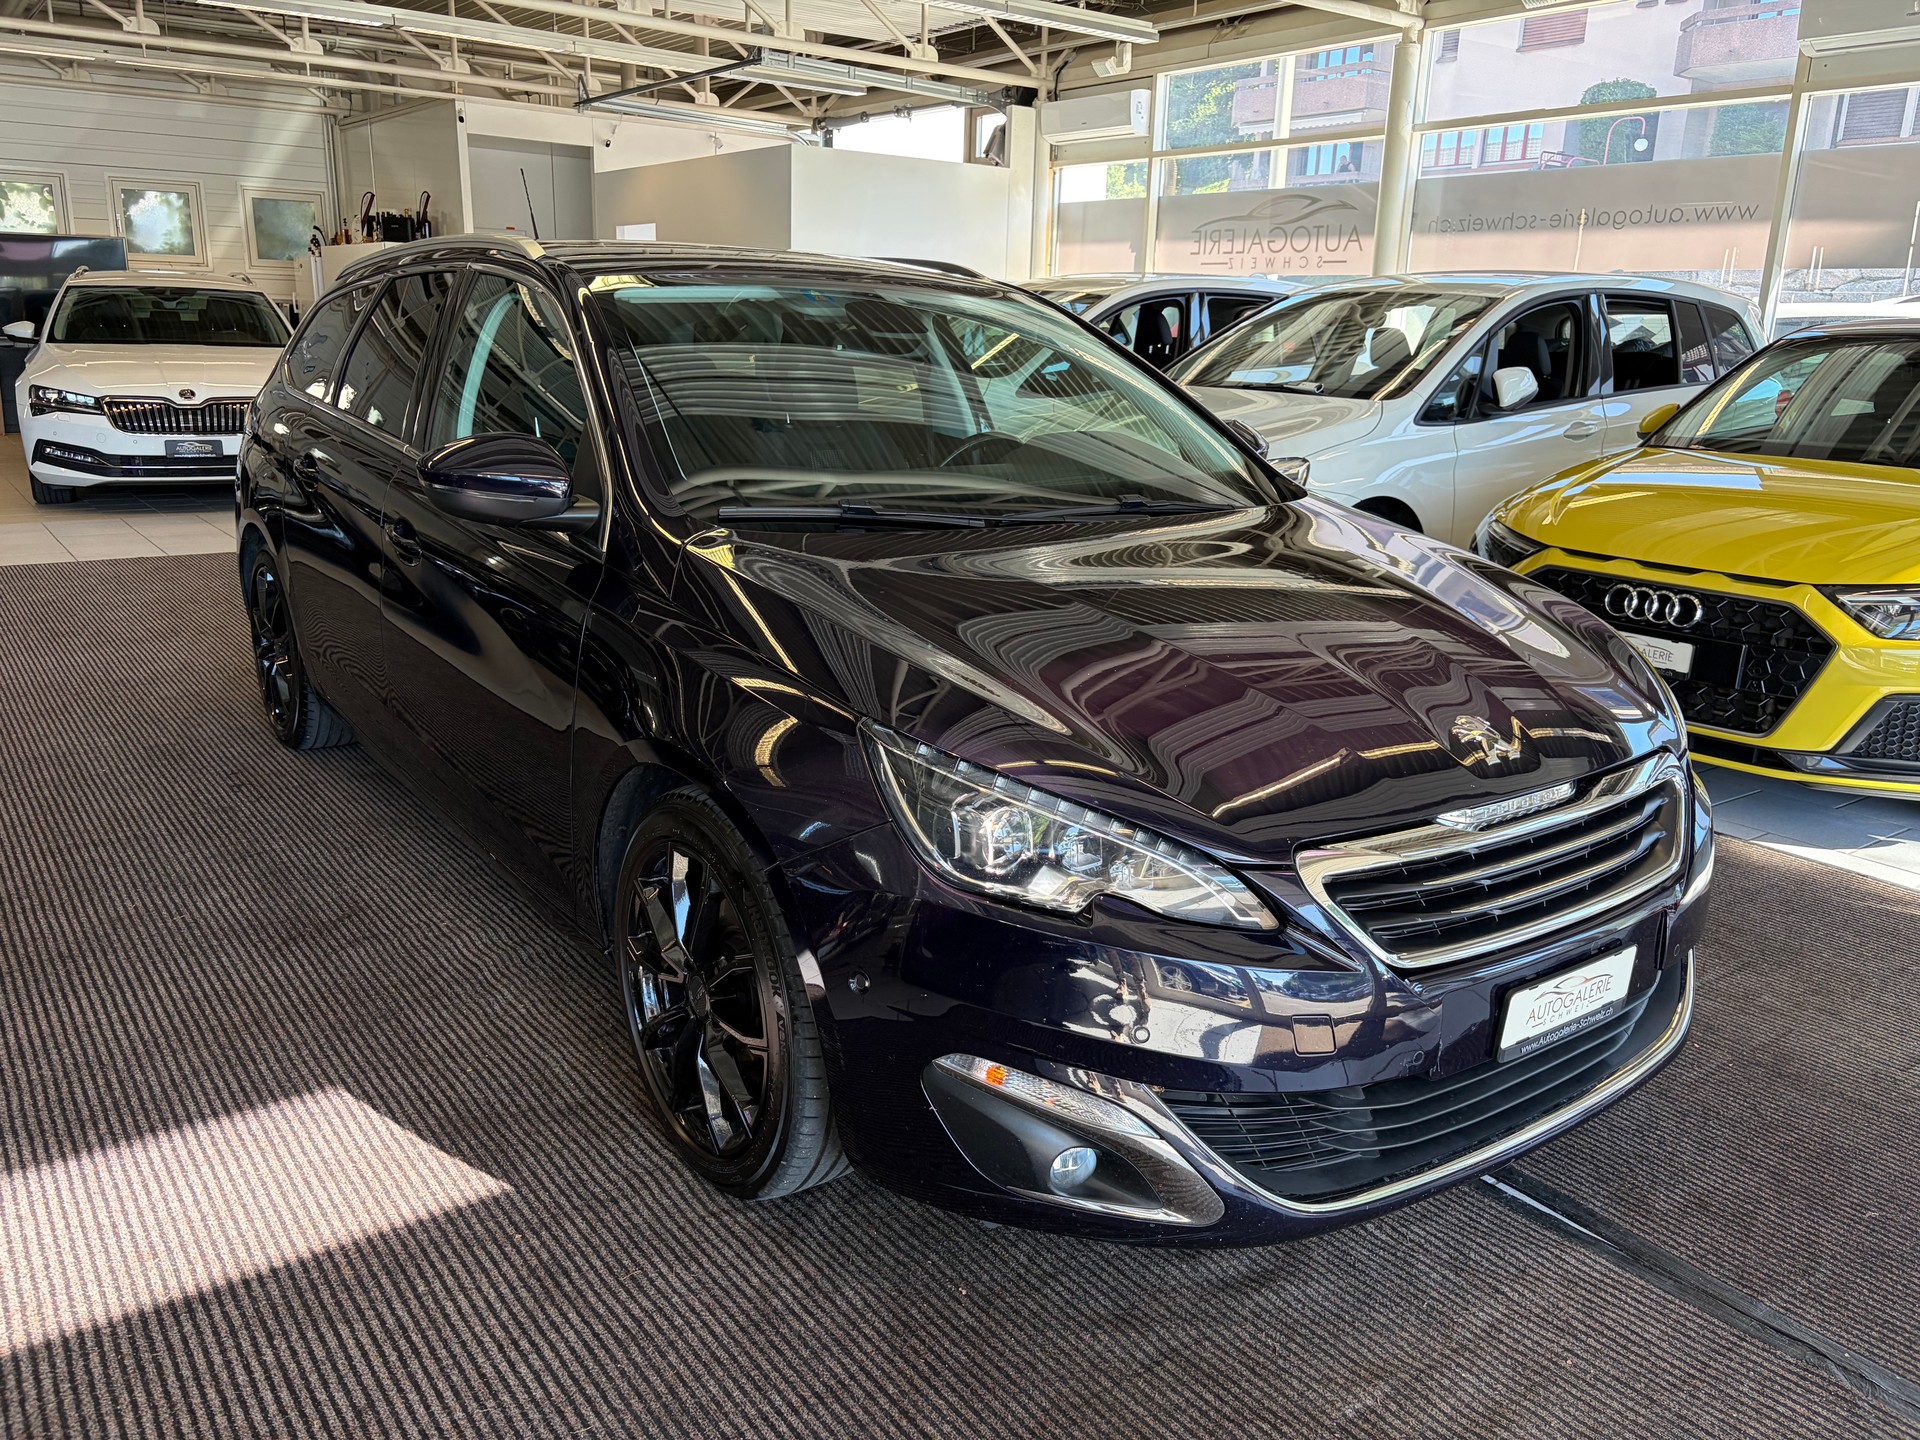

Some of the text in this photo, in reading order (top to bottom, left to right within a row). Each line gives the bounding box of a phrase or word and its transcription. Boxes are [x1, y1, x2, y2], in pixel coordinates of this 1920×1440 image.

[1642, 648, 1674, 662] ALERIE
[1526, 976, 1612, 1025] AUTOGALERIE
[1542, 1002, 1590, 1026] SCHWEIZ
